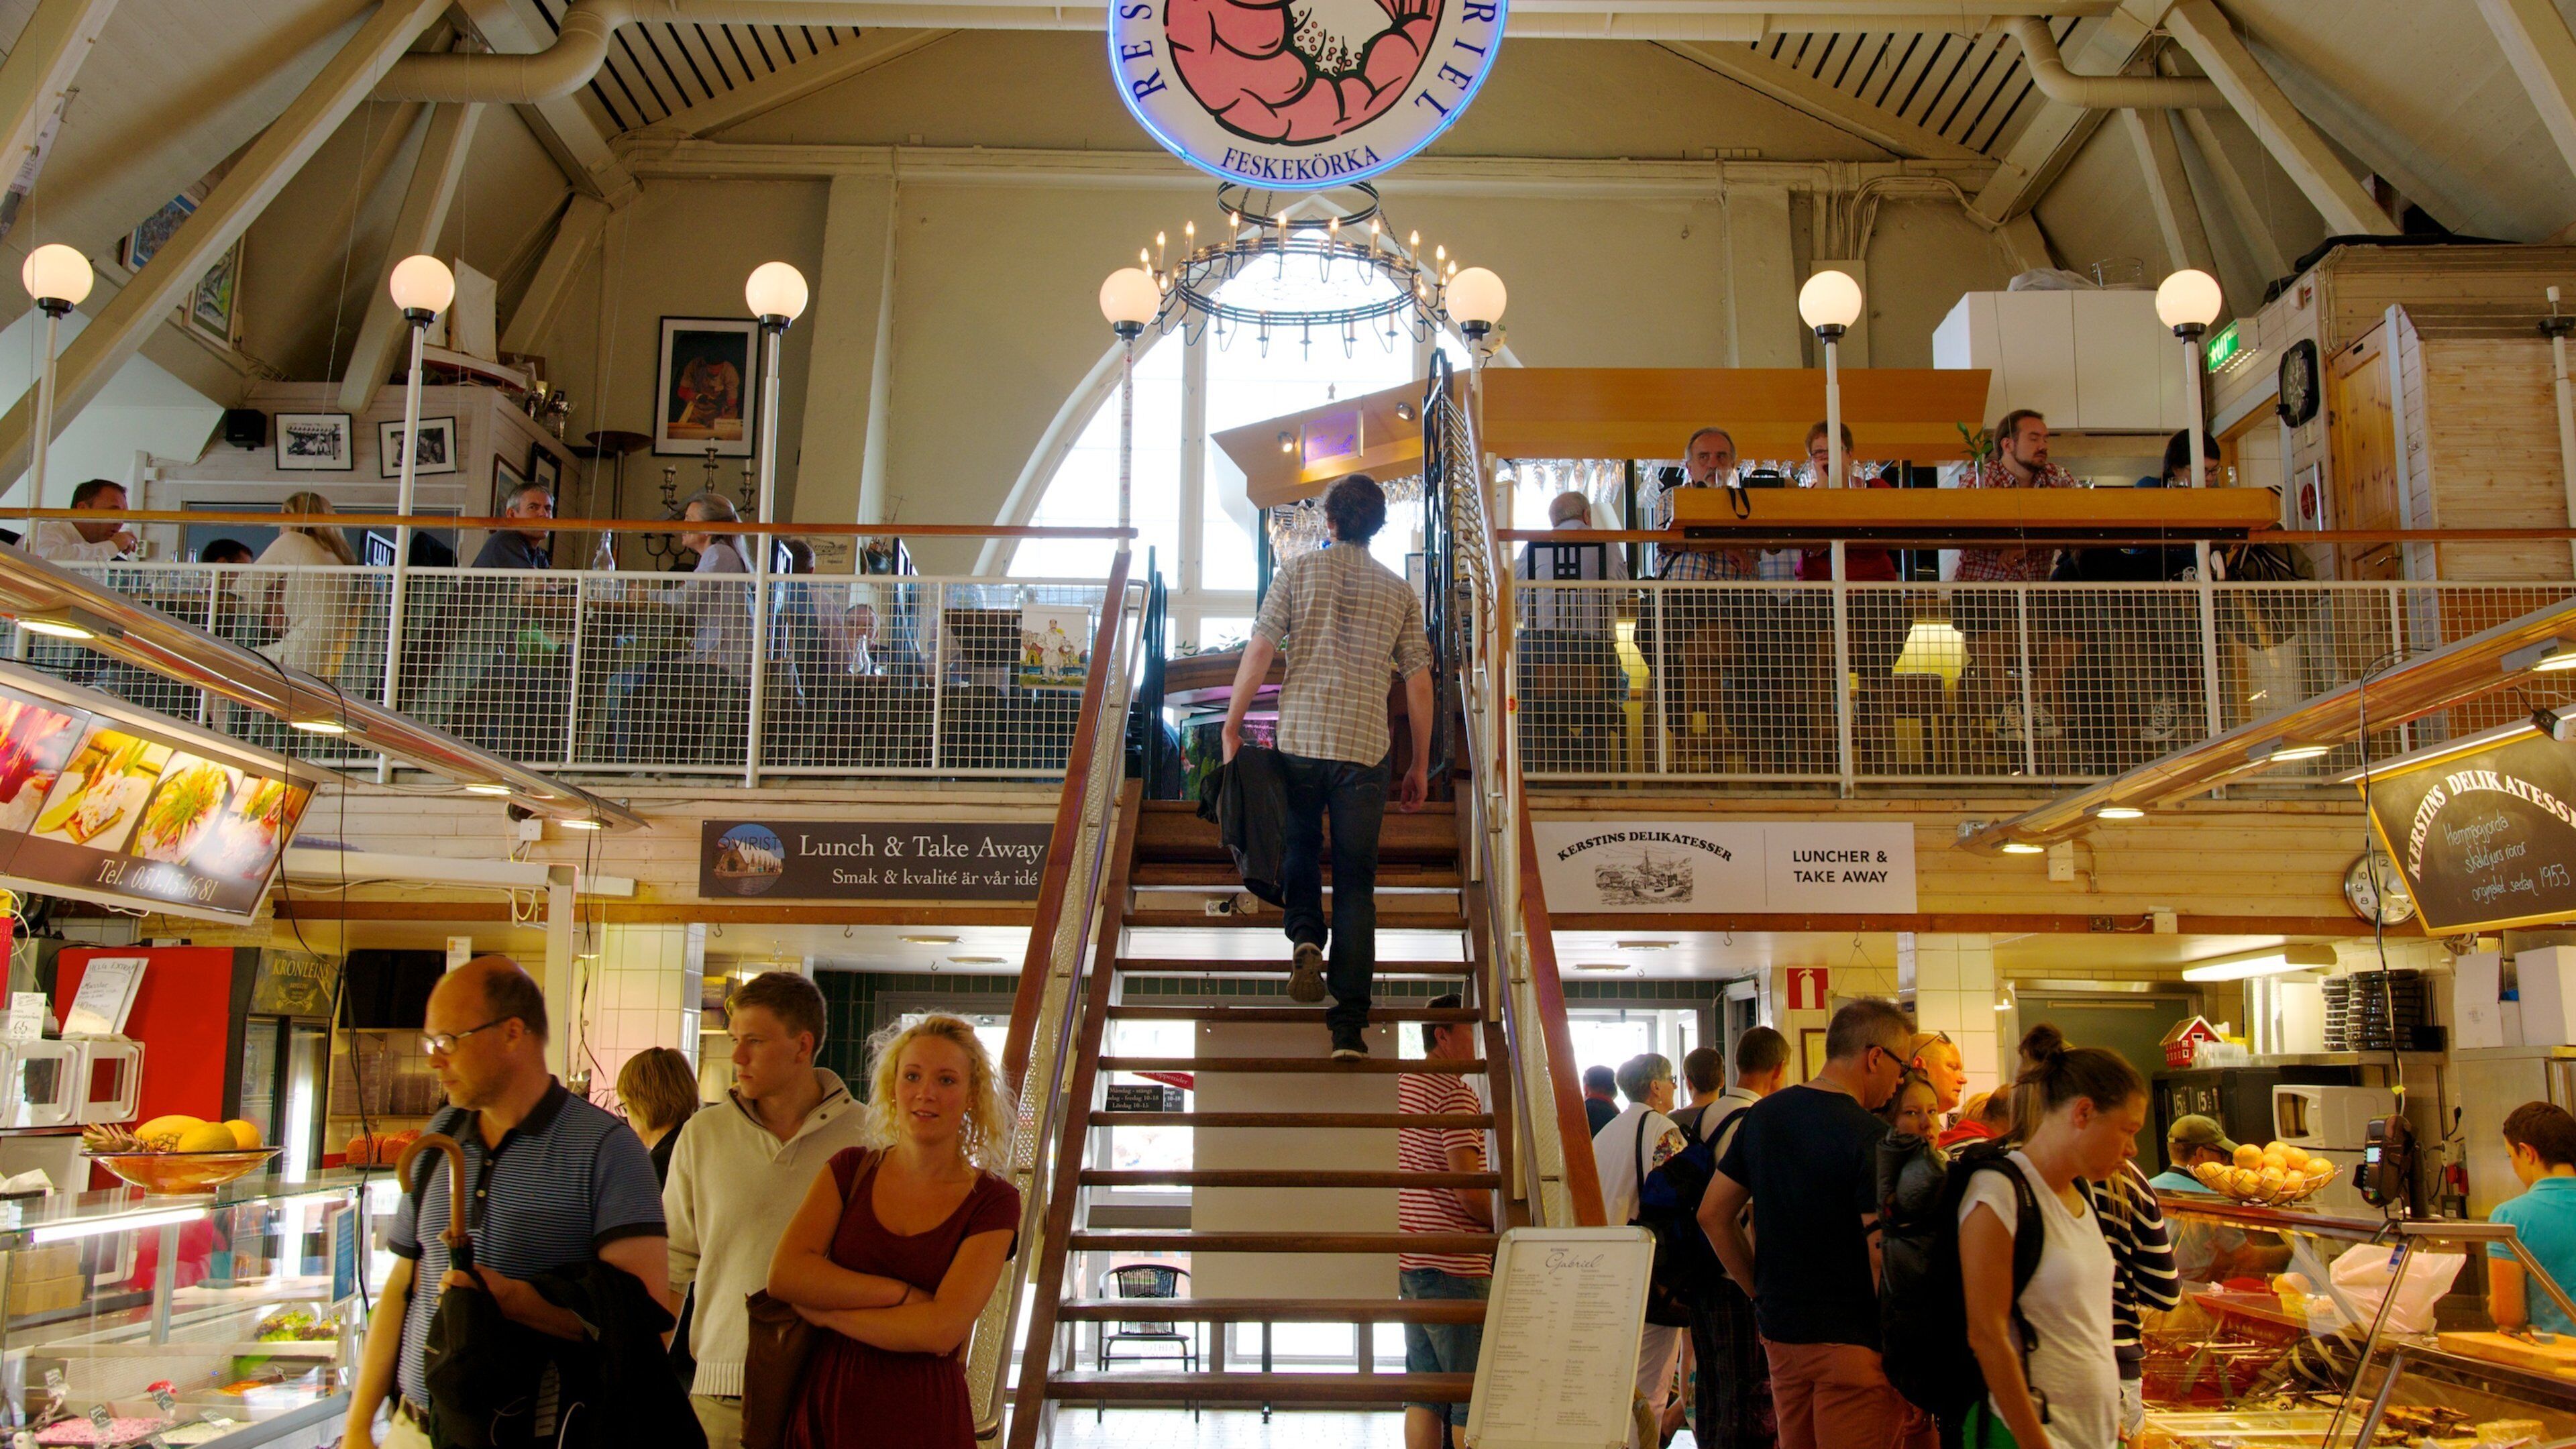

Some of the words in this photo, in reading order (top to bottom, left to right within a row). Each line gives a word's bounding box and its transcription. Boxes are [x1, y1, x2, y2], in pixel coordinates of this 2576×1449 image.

[1220, 145, 1381, 180] FESKEKÖRKA
[2408, 784, 2447, 883] KERSTINS
[2443, 809, 2510, 848] Hemmagjorda
[799, 834, 875, 857] Lunch
[883, 835, 905, 858] &
[912, 835, 969, 858] Take
[976, 836, 1044, 865] Away
[1556, 832, 1626, 862] KERSTINS
[1629, 831, 1732, 862] DELIKATESSER
[1792, 850, 1870, 863] LUNCHER
[1876, 850, 1888, 863] &
[96, 858, 127, 886] Tel.
[2379, 859, 2389, 867] 12
[2465, 847, 2504, 874] skaldjurs
[832, 868, 878, 885] Smak
[883, 869, 898, 885] &
[902, 869, 957, 885] kvalité
[961, 871, 979, 885] är
[983, 870, 1010, 885] vår
[1014, 870, 1038, 886] idé
[1793, 870, 1835, 883] TAKE
[1841, 870, 1888, 883] AWAY
[2358, 871, 2367, 879] 10
[2510, 872, 2538, 896] sedan
[2540, 863, 2571, 888] 1953
[2355, 884, 2363, 892] 9
[2361, 897, 2369, 905] 8
[1545, 1252, 1605, 1275] Gabriel
